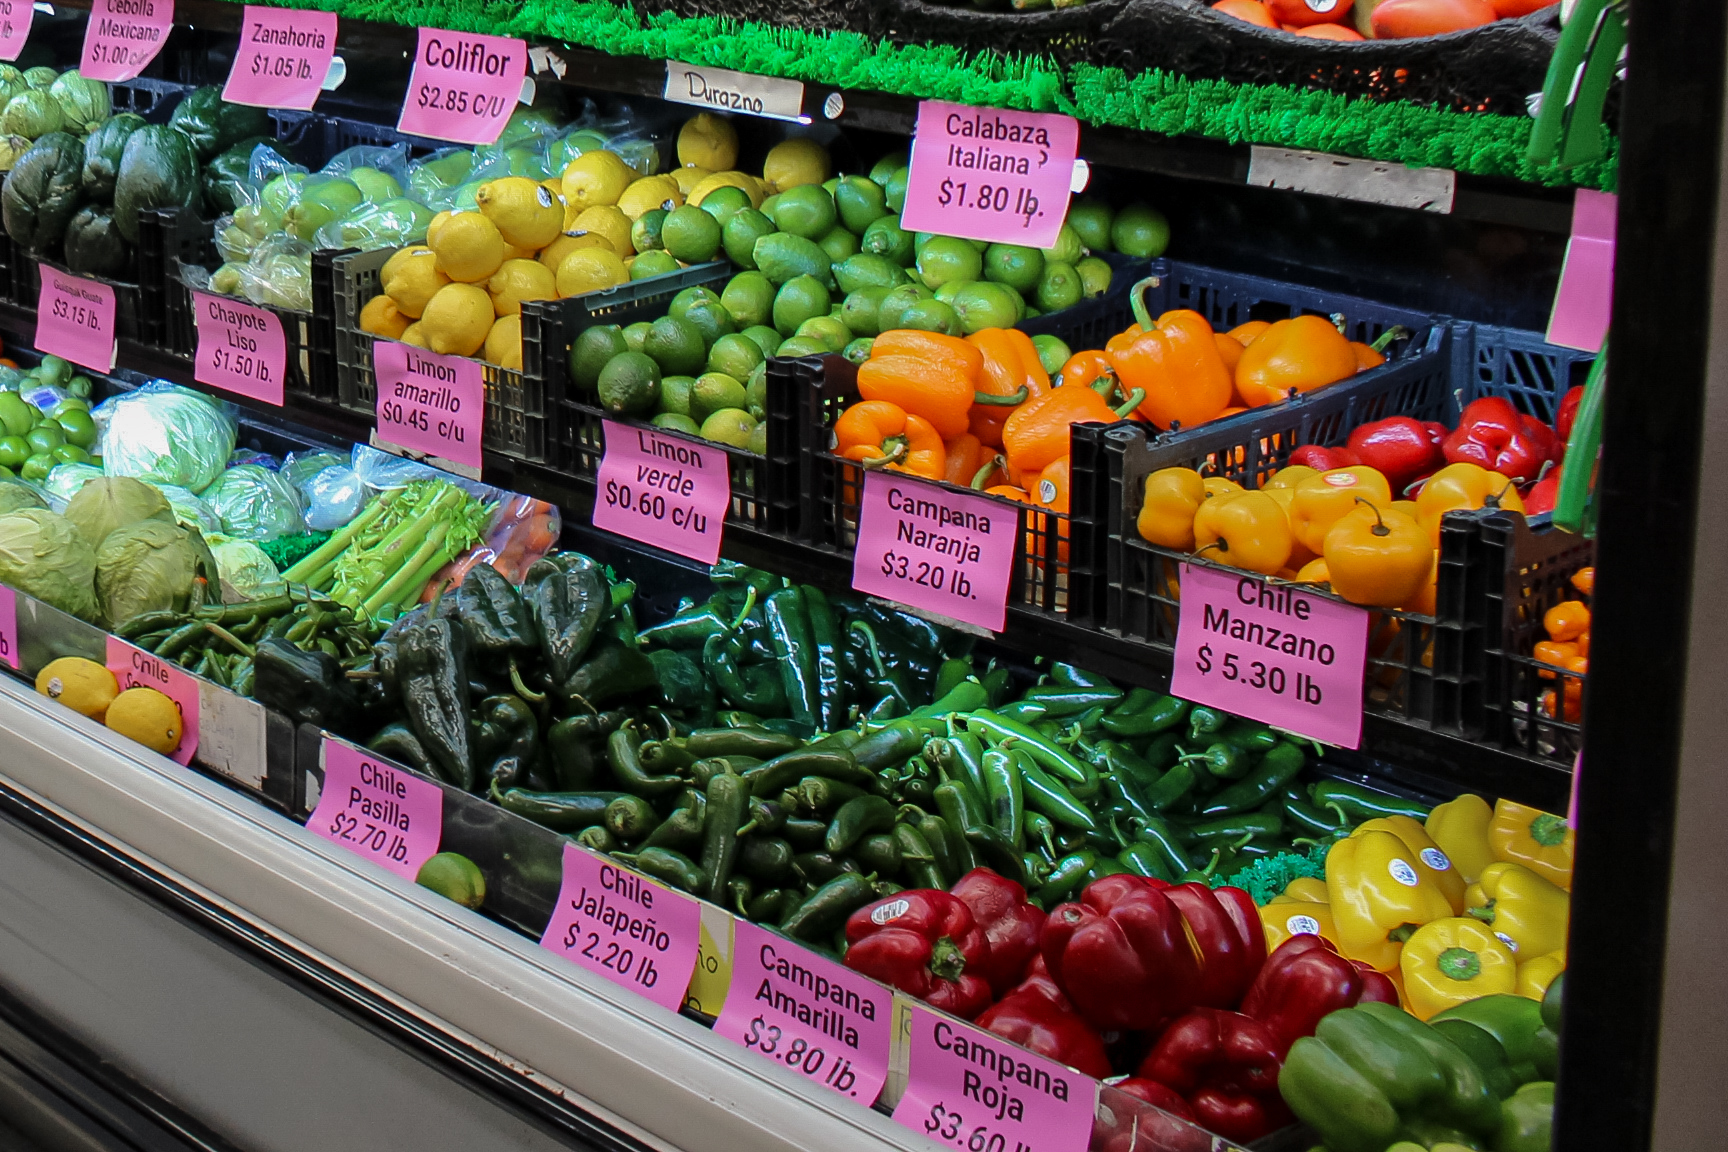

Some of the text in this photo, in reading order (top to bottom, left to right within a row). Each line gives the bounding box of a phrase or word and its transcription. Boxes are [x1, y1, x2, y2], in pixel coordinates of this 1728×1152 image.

[4, 20, 14, 39] lb
[98, 21, 160, 43] Mexicana
[250, 22, 326, 50] Zanahoria
[91, 41, 127, 66] $1.00
[251, 54, 294, 79] $1.05
[424, 38, 511, 79] Coliflor
[417, 81, 507, 119] $2.85 C/U
[684, 70, 764, 115] Durazno
[946, 112, 1048, 147] Calabaza
[947, 143, 1030, 176] Italiana
[937, 177, 1010, 214] $1.80
[52, 297, 85, 326] $3.15
[208, 301, 268, 334] Chayote
[212, 347, 254, 378] $1.50
[226, 328, 258, 354] Liso
[406, 352, 458, 385] Limon
[393, 379, 462, 414] amarillo
[382, 400, 466, 444] $0.45 c/u
[637, 429, 704, 471] Limon
[635, 463, 695, 498] verde
[605, 479, 708, 536] $0.60 c/u
[887, 487, 992, 536] Campana
[896, 519, 982, 566] Naranja
[880, 548, 978, 602] $3.20 lb.
[1236, 576, 1312, 622] Chile
[1202, 602, 1336, 666] Manzano
[132, 650, 170, 685] Chile
[1194, 642, 1323, 706] $ 5.30 lb
[359, 761, 408, 800] Chile
[348, 785, 411, 833] Pasilla
[329, 810, 388, 854] $2.70
[598, 863, 655, 911] Chile
[570, 885, 671, 954] Jalapeño
[581, 930, 635, 978] 2.20
[634, 953, 660, 990] lb
[758, 943, 877, 1023] Campana
[753, 977, 862, 1050] Amarilla
[742, 1013, 826, 1079] $3.80
[931, 1020, 1071, 1105] Campana
[961, 1069, 1025, 1124] Roja
[923, 1100, 1006, 1152] $3.60
